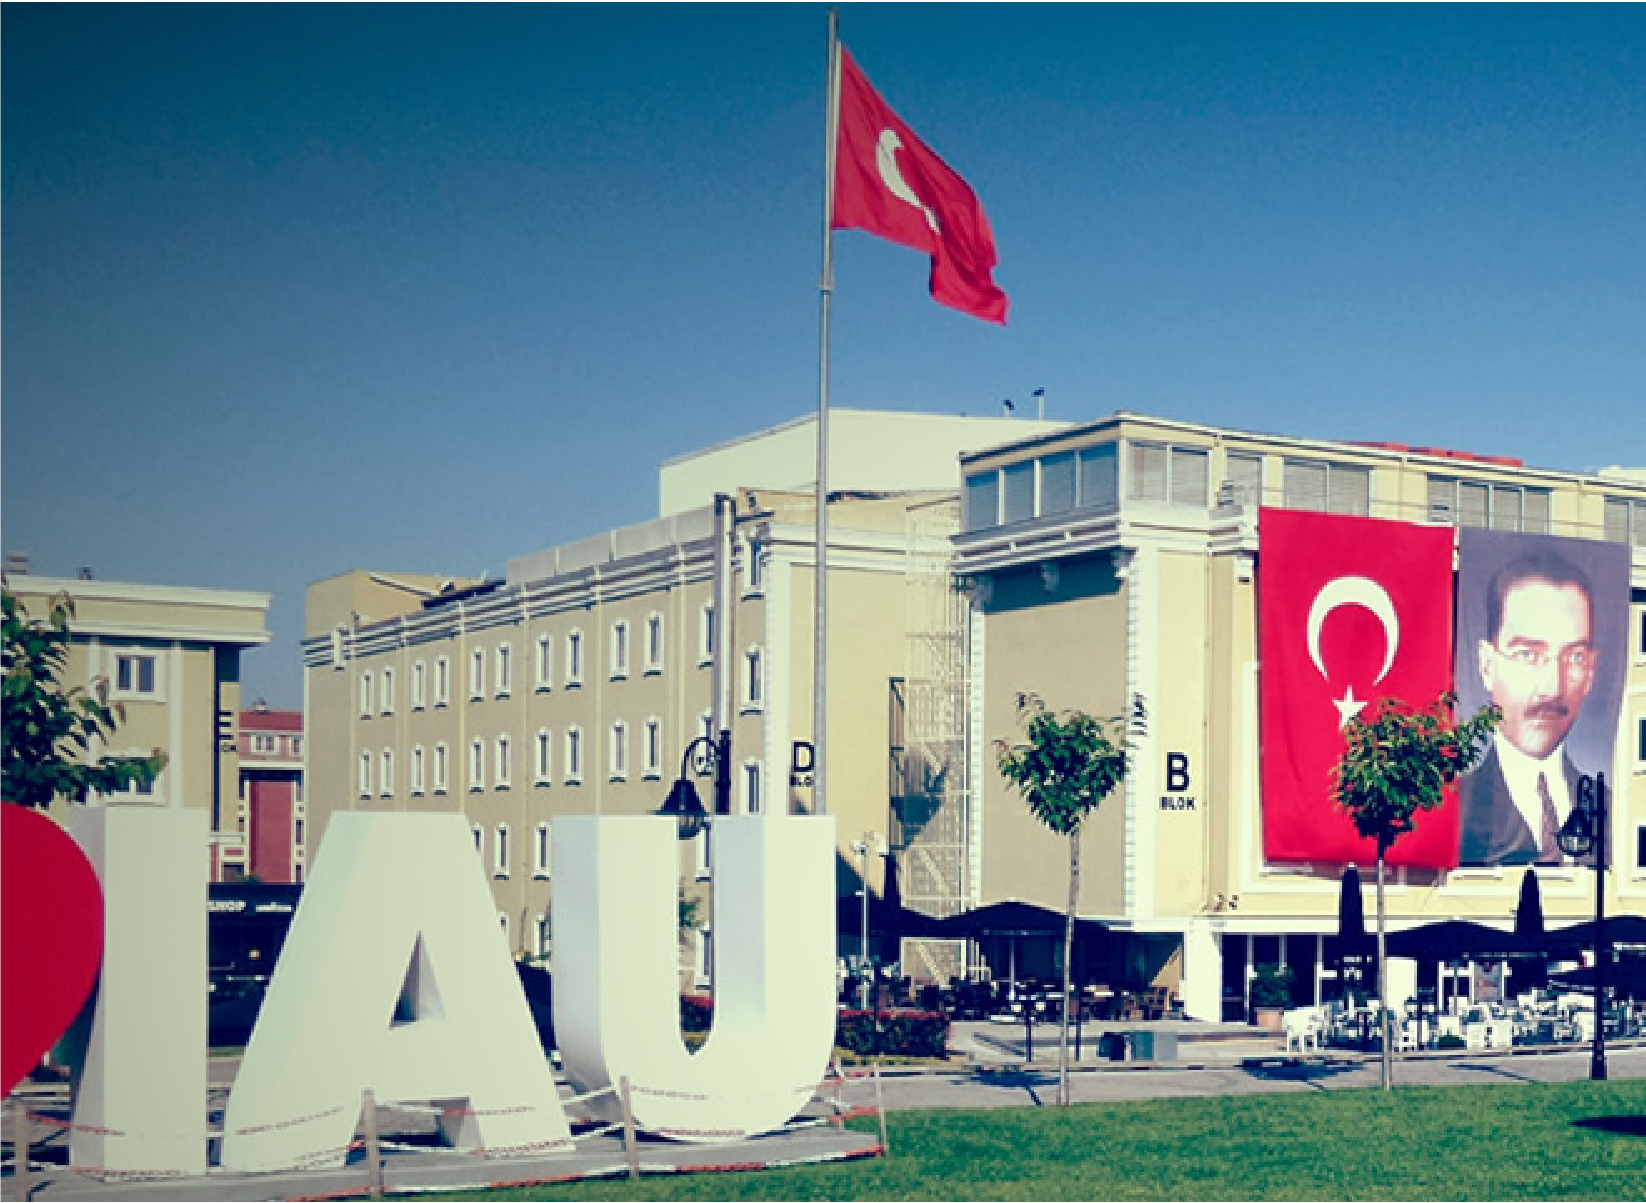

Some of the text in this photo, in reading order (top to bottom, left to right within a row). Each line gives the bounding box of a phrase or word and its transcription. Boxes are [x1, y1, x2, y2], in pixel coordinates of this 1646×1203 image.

[791, 740, 815, 772] D
[1166, 751, 1190, 792] B
[788, 774, 815, 787] BLO
[1158, 796, 1197, 811] BLOK
[70, 806, 838, 1178] IAU
